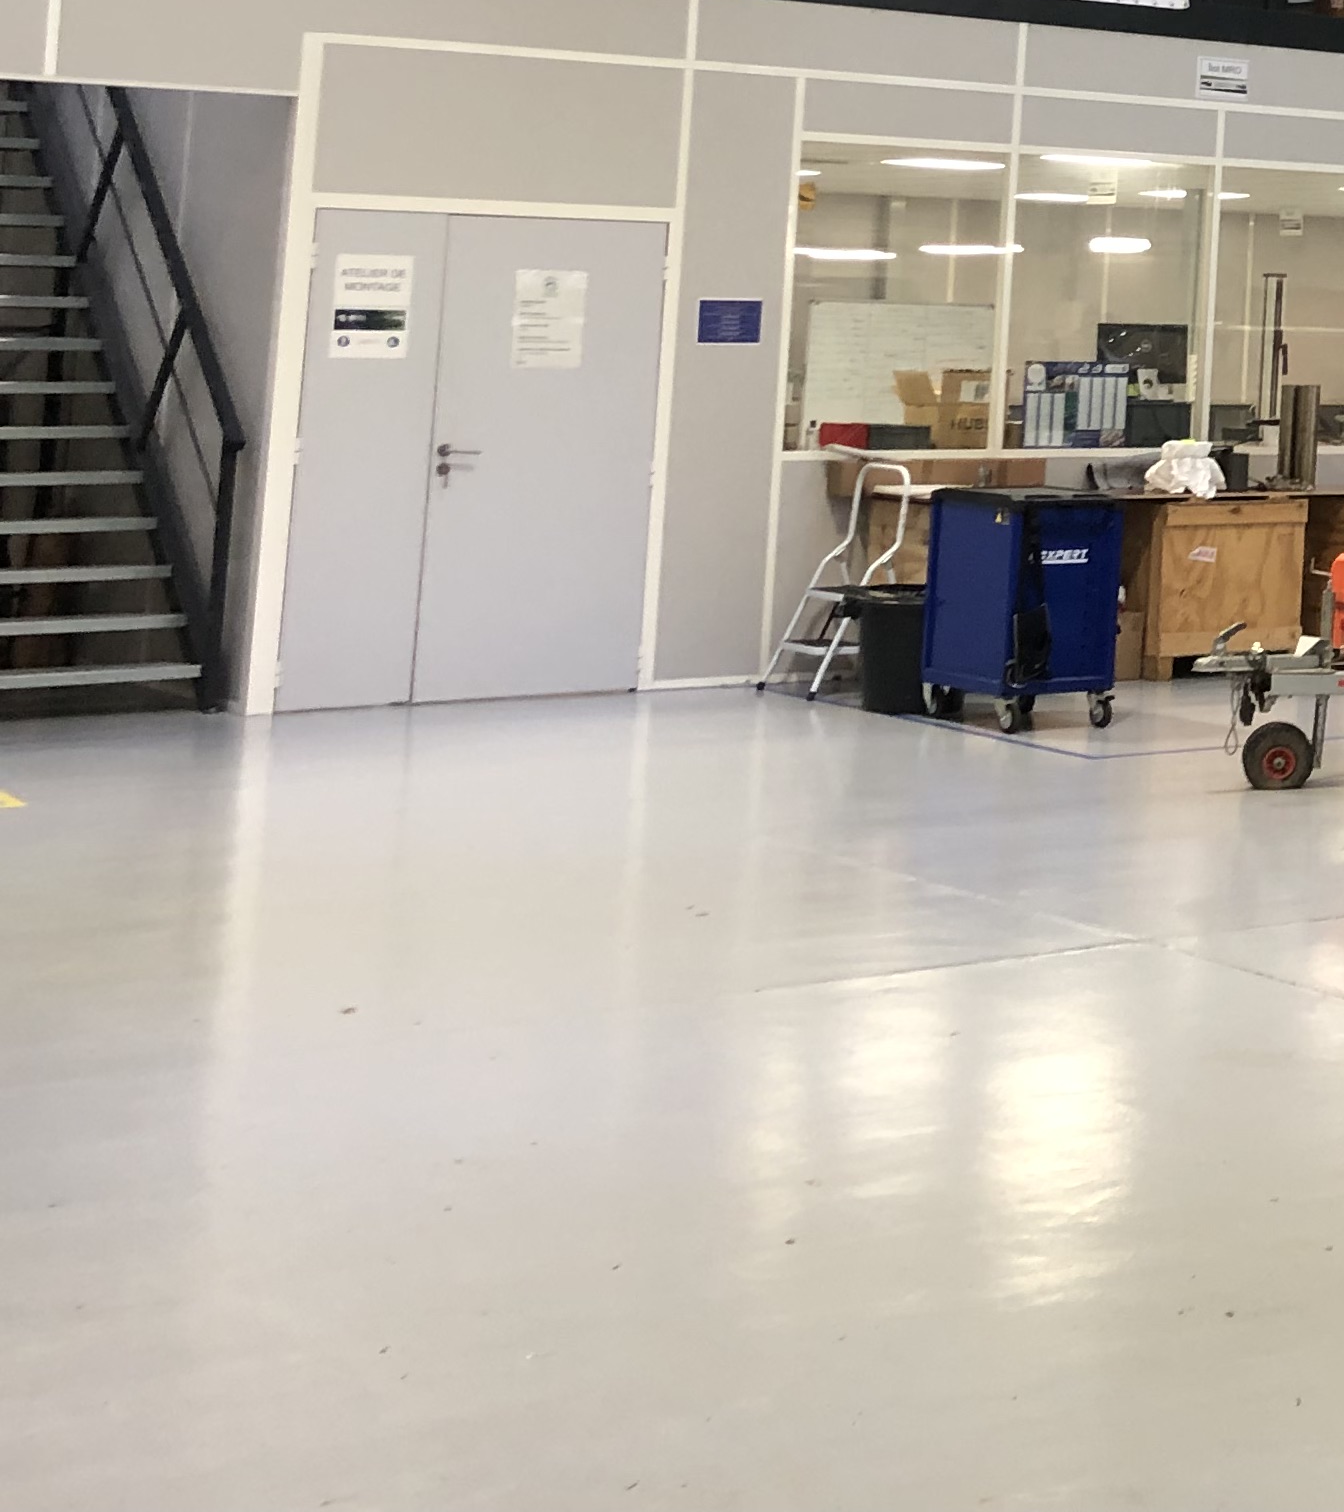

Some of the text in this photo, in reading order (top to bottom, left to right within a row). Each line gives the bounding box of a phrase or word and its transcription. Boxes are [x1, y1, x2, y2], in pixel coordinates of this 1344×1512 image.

[341, 268, 406, 278] ATELIER DE
[344, 282, 401, 292] MONTAGE
